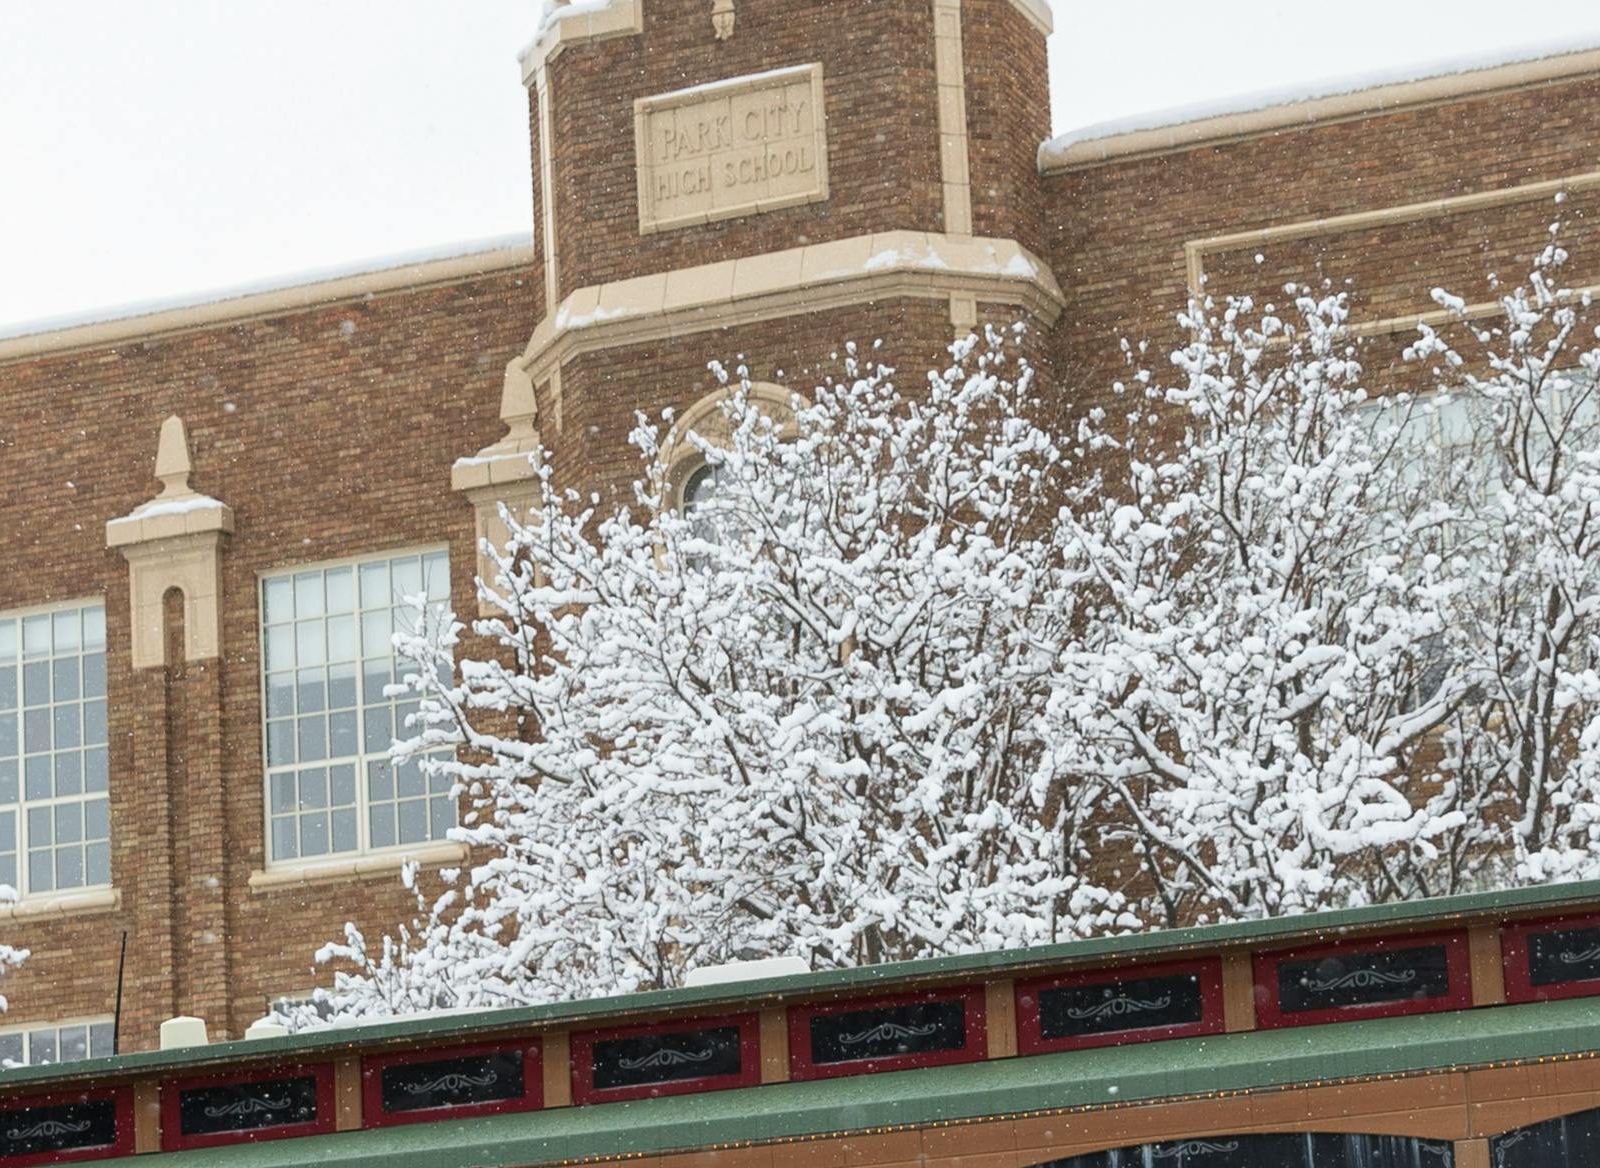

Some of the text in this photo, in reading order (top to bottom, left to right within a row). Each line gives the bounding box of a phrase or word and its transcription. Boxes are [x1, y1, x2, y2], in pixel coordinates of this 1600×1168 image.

[662, 101, 806, 160] PARK CITY
[657, 147, 814, 201] HIGH SCHOOL
